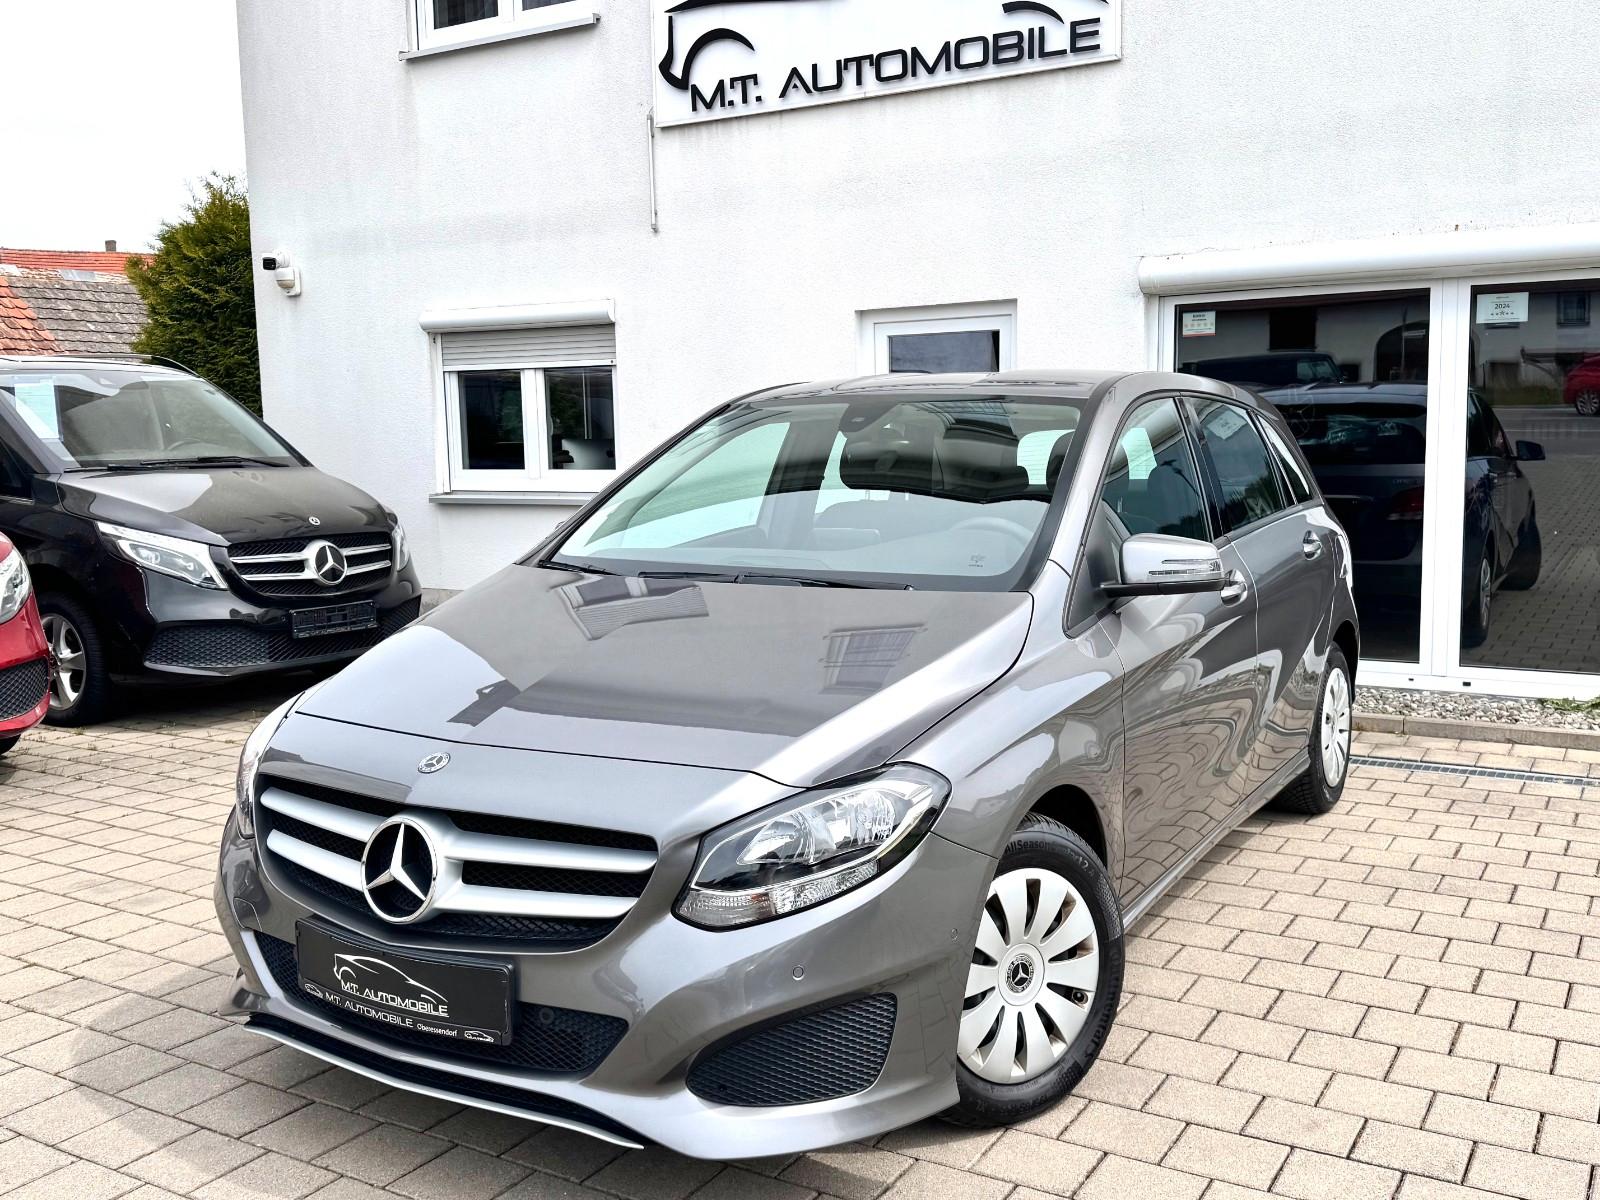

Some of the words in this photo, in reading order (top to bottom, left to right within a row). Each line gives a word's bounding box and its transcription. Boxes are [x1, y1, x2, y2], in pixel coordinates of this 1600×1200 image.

[690, 73, 762, 112] M.T.
[778, 17, 1101, 99] AUTOMOBILE
[325, 992, 342, 1006] M.T.
[344, 1001, 414, 1028] AUTOMOBILE
[416, 1023, 458, 1037] Oberessendorf
[341, 980, 360, 996] M.T.
[363, 988, 449, 1015] AUTOMOBILE
